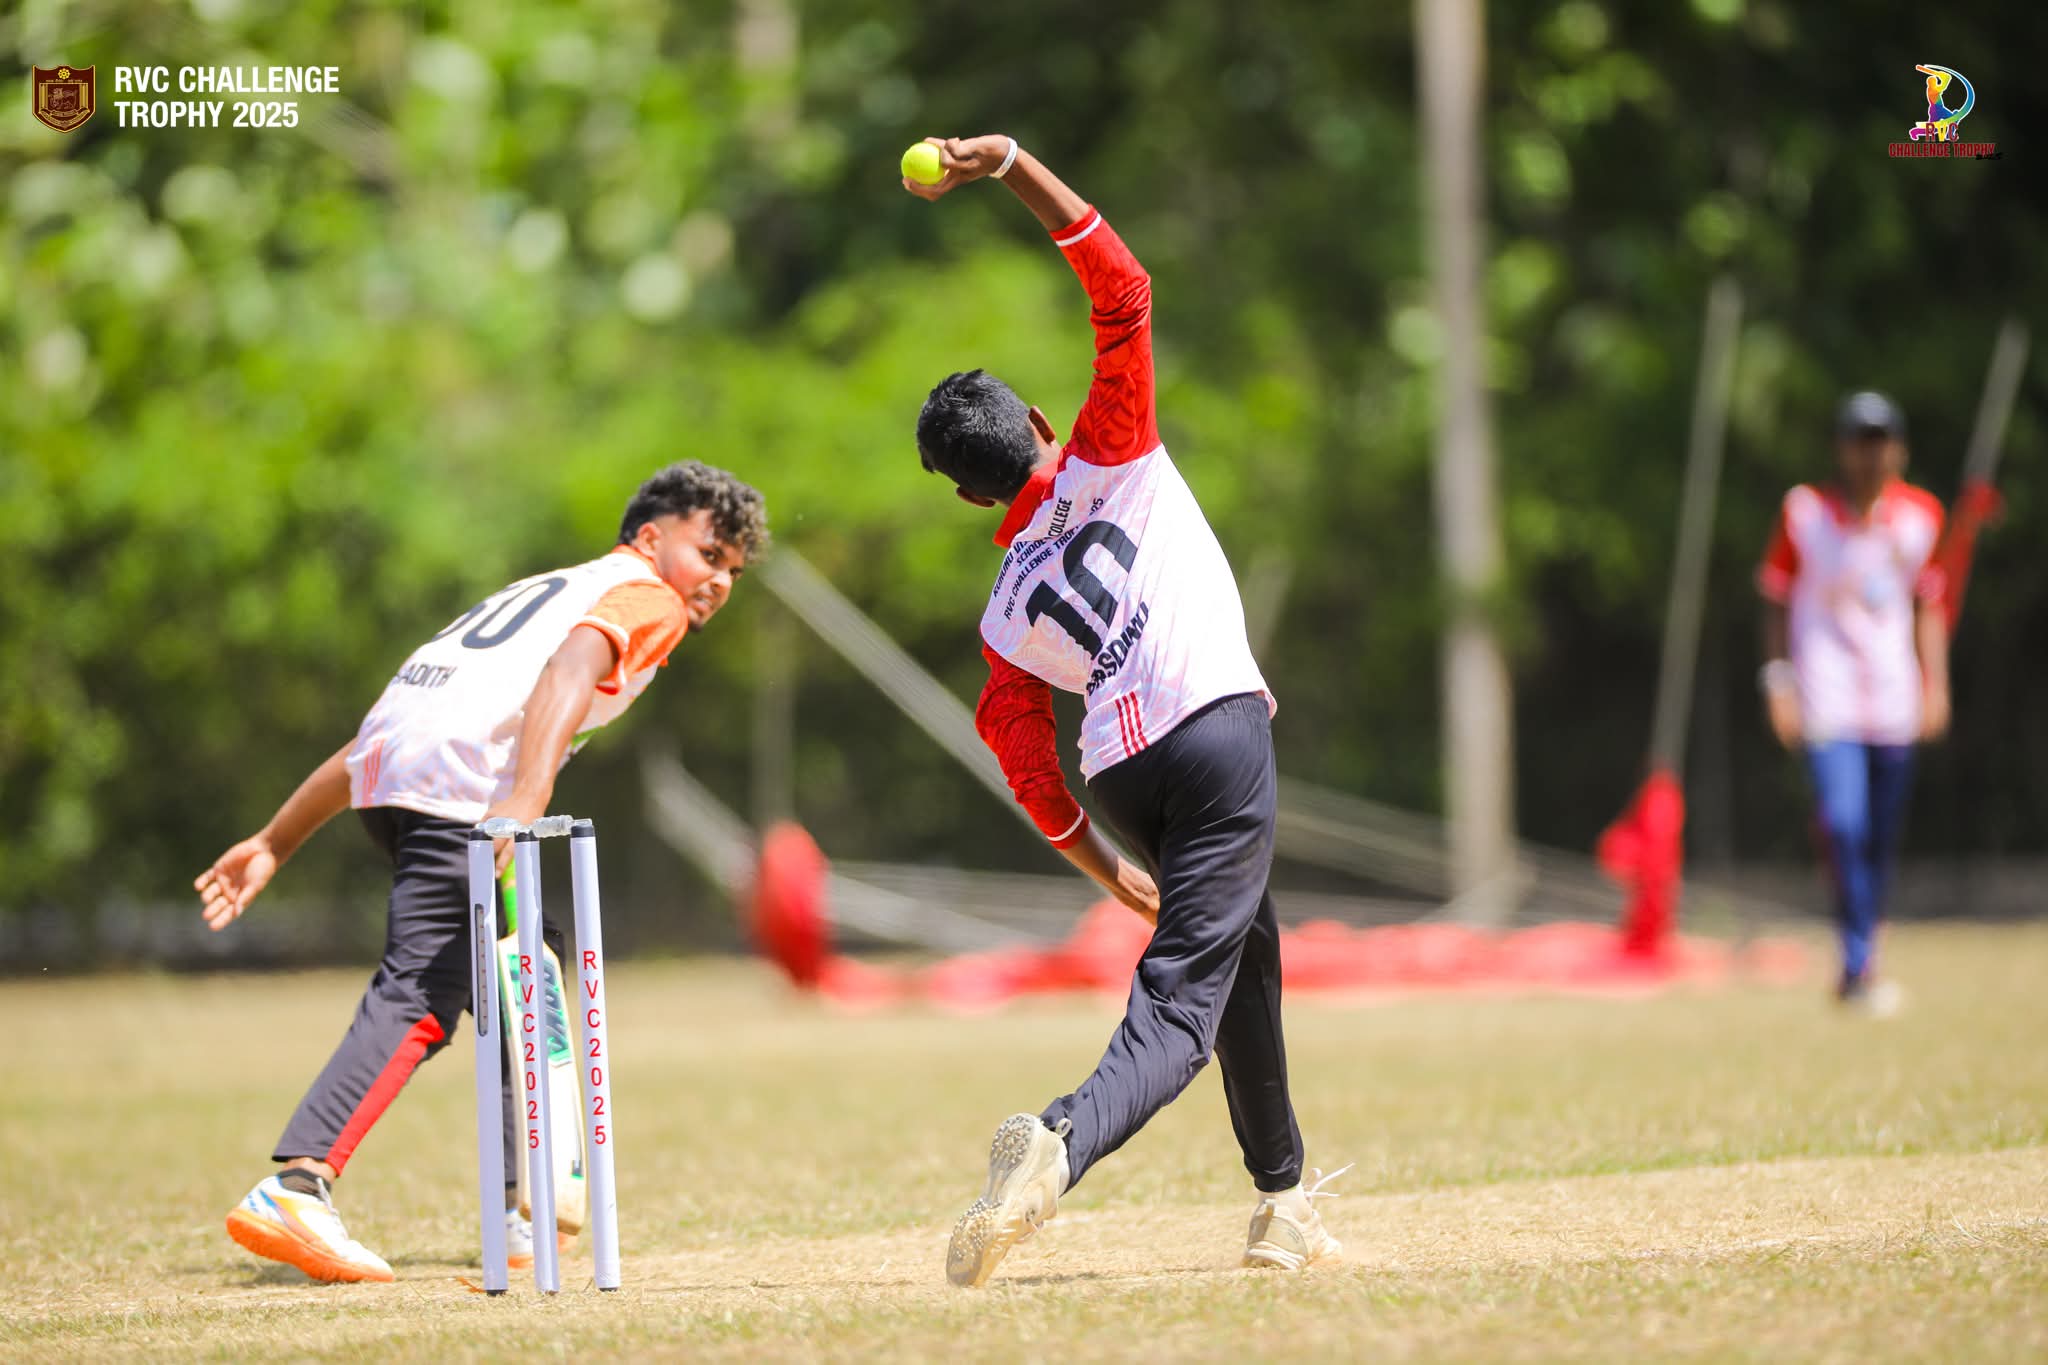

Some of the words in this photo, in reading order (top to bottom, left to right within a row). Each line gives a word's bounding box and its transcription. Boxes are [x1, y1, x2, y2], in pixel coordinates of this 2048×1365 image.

[1003, 596, 1016, 620] RVC
[1011, 547, 1054, 596] CHALLENGE
[1052, 525, 1080, 550] TROP
[1047, 497, 1073, 540] COLLEGE
[1025, 520, 1138, 661] 10
[520, 955, 540, 1149] RVC2025
[583, 950, 607, 1145] RVC2025
